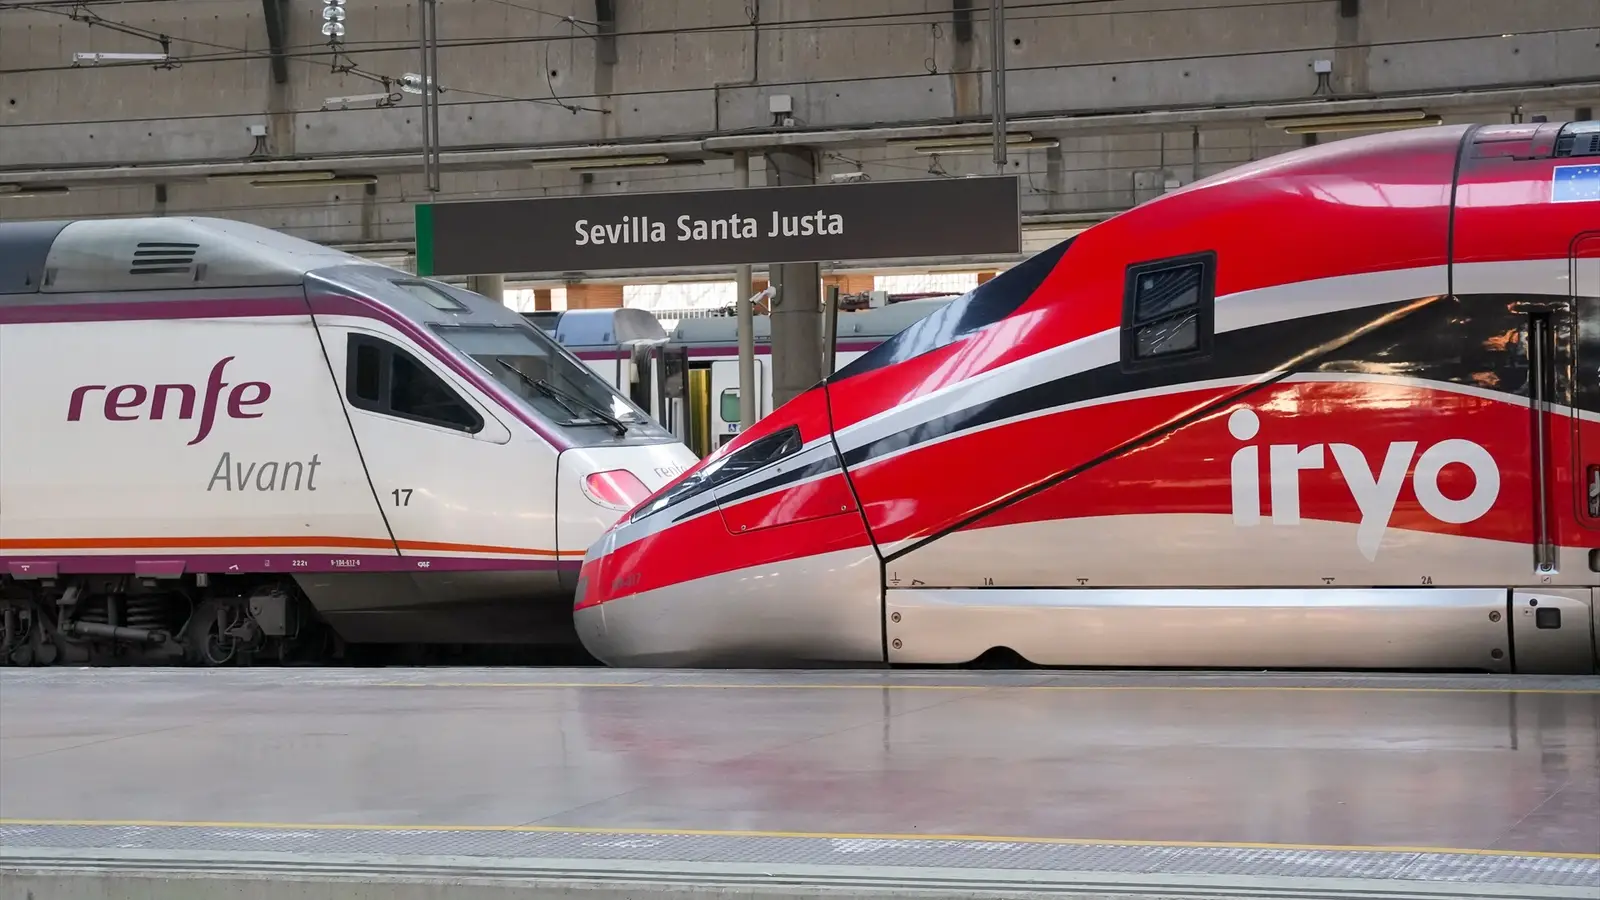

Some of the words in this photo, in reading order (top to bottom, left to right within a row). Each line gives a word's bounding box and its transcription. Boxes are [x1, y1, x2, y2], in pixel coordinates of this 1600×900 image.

[574, 215, 666, 246] Sevilla
[677, 213, 758, 242] Santa
[767, 209, 844, 238] Justa
[67, 355, 272, 446] renfe
[206, 451, 322, 492] Avant
[1228, 408, 1500, 562] iryo
[391, 488, 414, 507] 17
[983, 577, 994, 586] 1A
[1421, 575, 1433, 585] 2A
